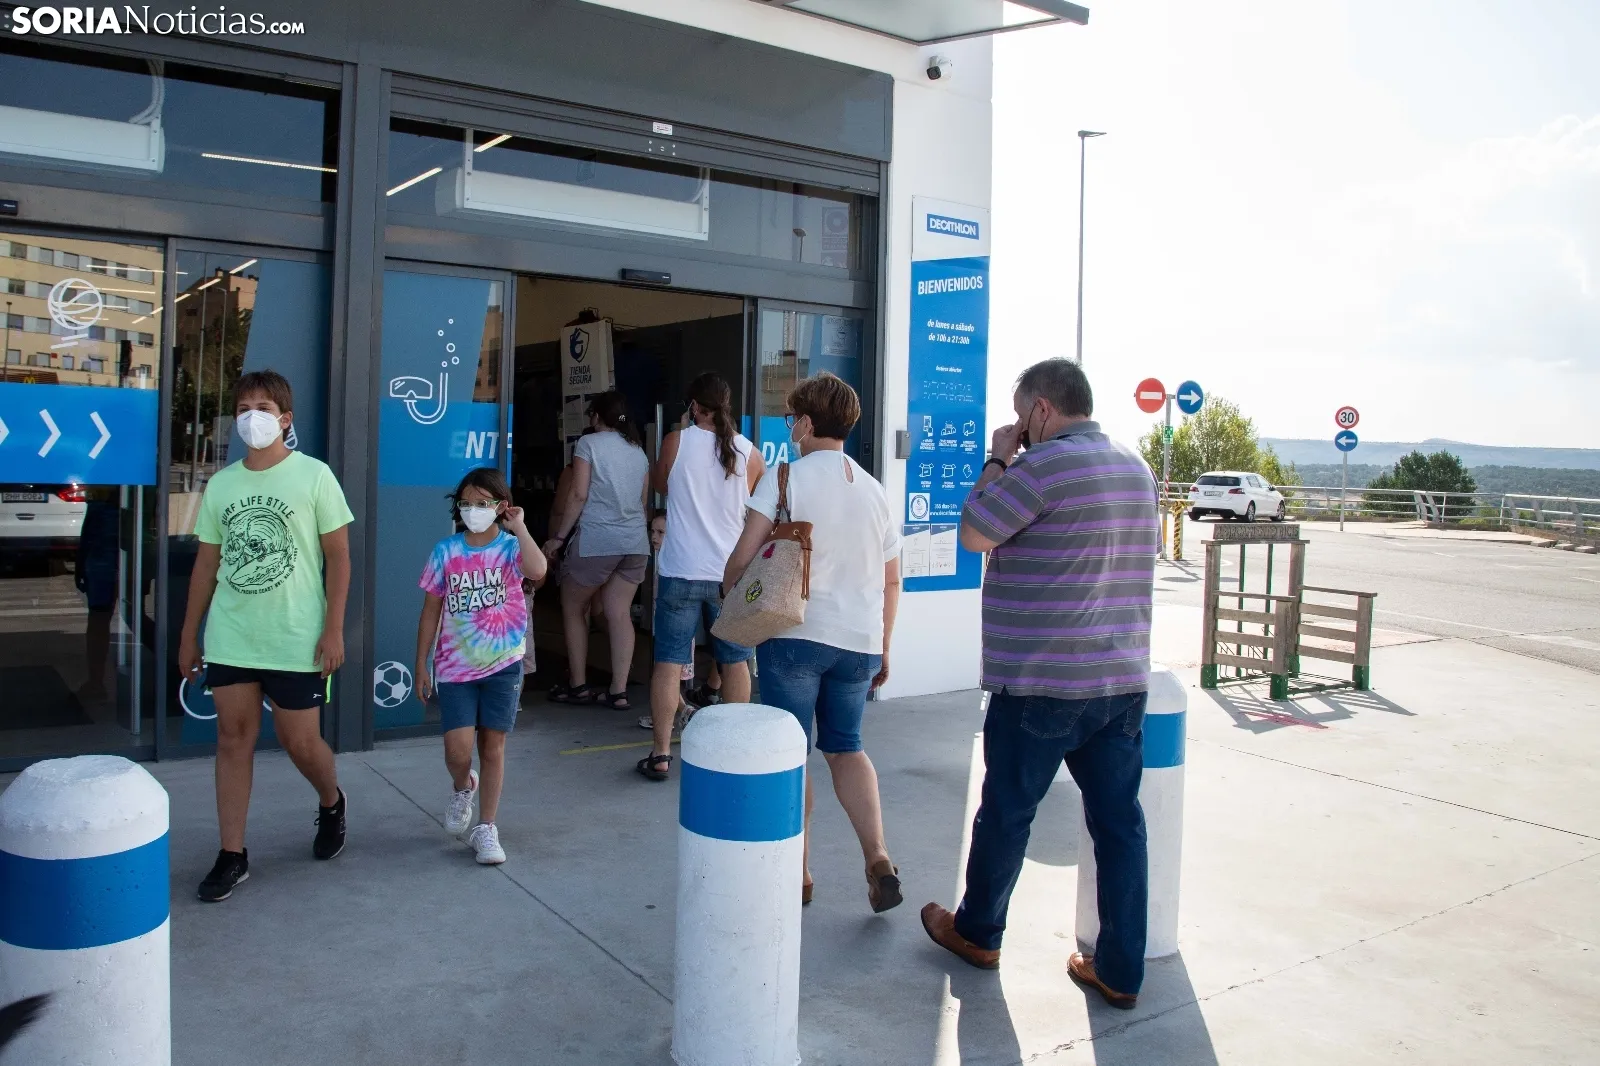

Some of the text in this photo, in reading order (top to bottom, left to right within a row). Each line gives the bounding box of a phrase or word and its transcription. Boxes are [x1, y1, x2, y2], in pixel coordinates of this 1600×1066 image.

[929, 217, 977, 236] DECATHLON
[917, 275, 983, 295] BIENVENIDOS
[927, 318, 934, 328] de
[935, 319, 950, 330] lunes
[928, 333, 935, 341] de
[570, 365, 591, 376] TIENDA
[569, 374, 592, 385] SEGURA
[1340, 411, 1355, 424] 30
[221, 495, 295, 526] SURF LIFE STYLE
[449, 567, 503, 593] PALM
[447, 583, 507, 615] BEACH
